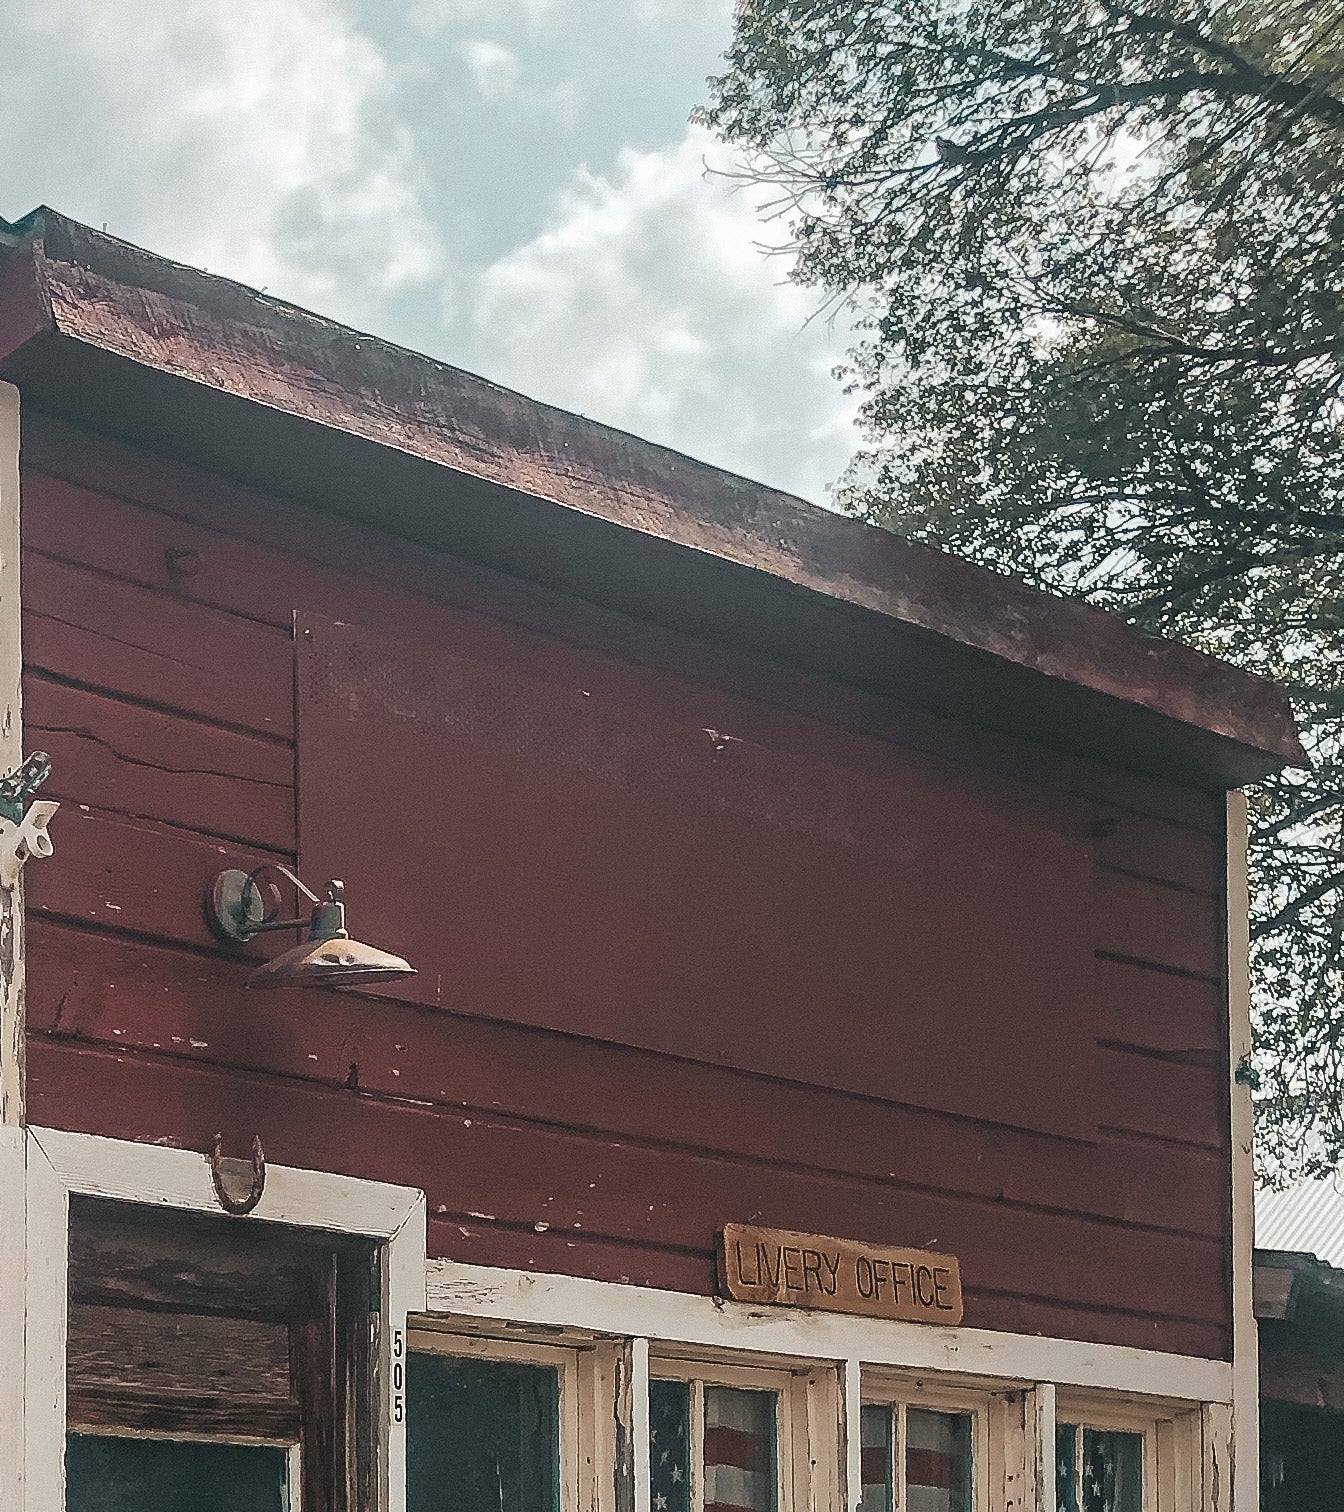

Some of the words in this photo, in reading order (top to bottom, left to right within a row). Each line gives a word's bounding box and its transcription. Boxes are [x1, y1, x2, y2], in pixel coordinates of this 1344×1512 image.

[735, 1240, 841, 1296] LIVERY
[855, 1255, 953, 1310] OFFICE
[393, 1329, 404, 1423] 505
